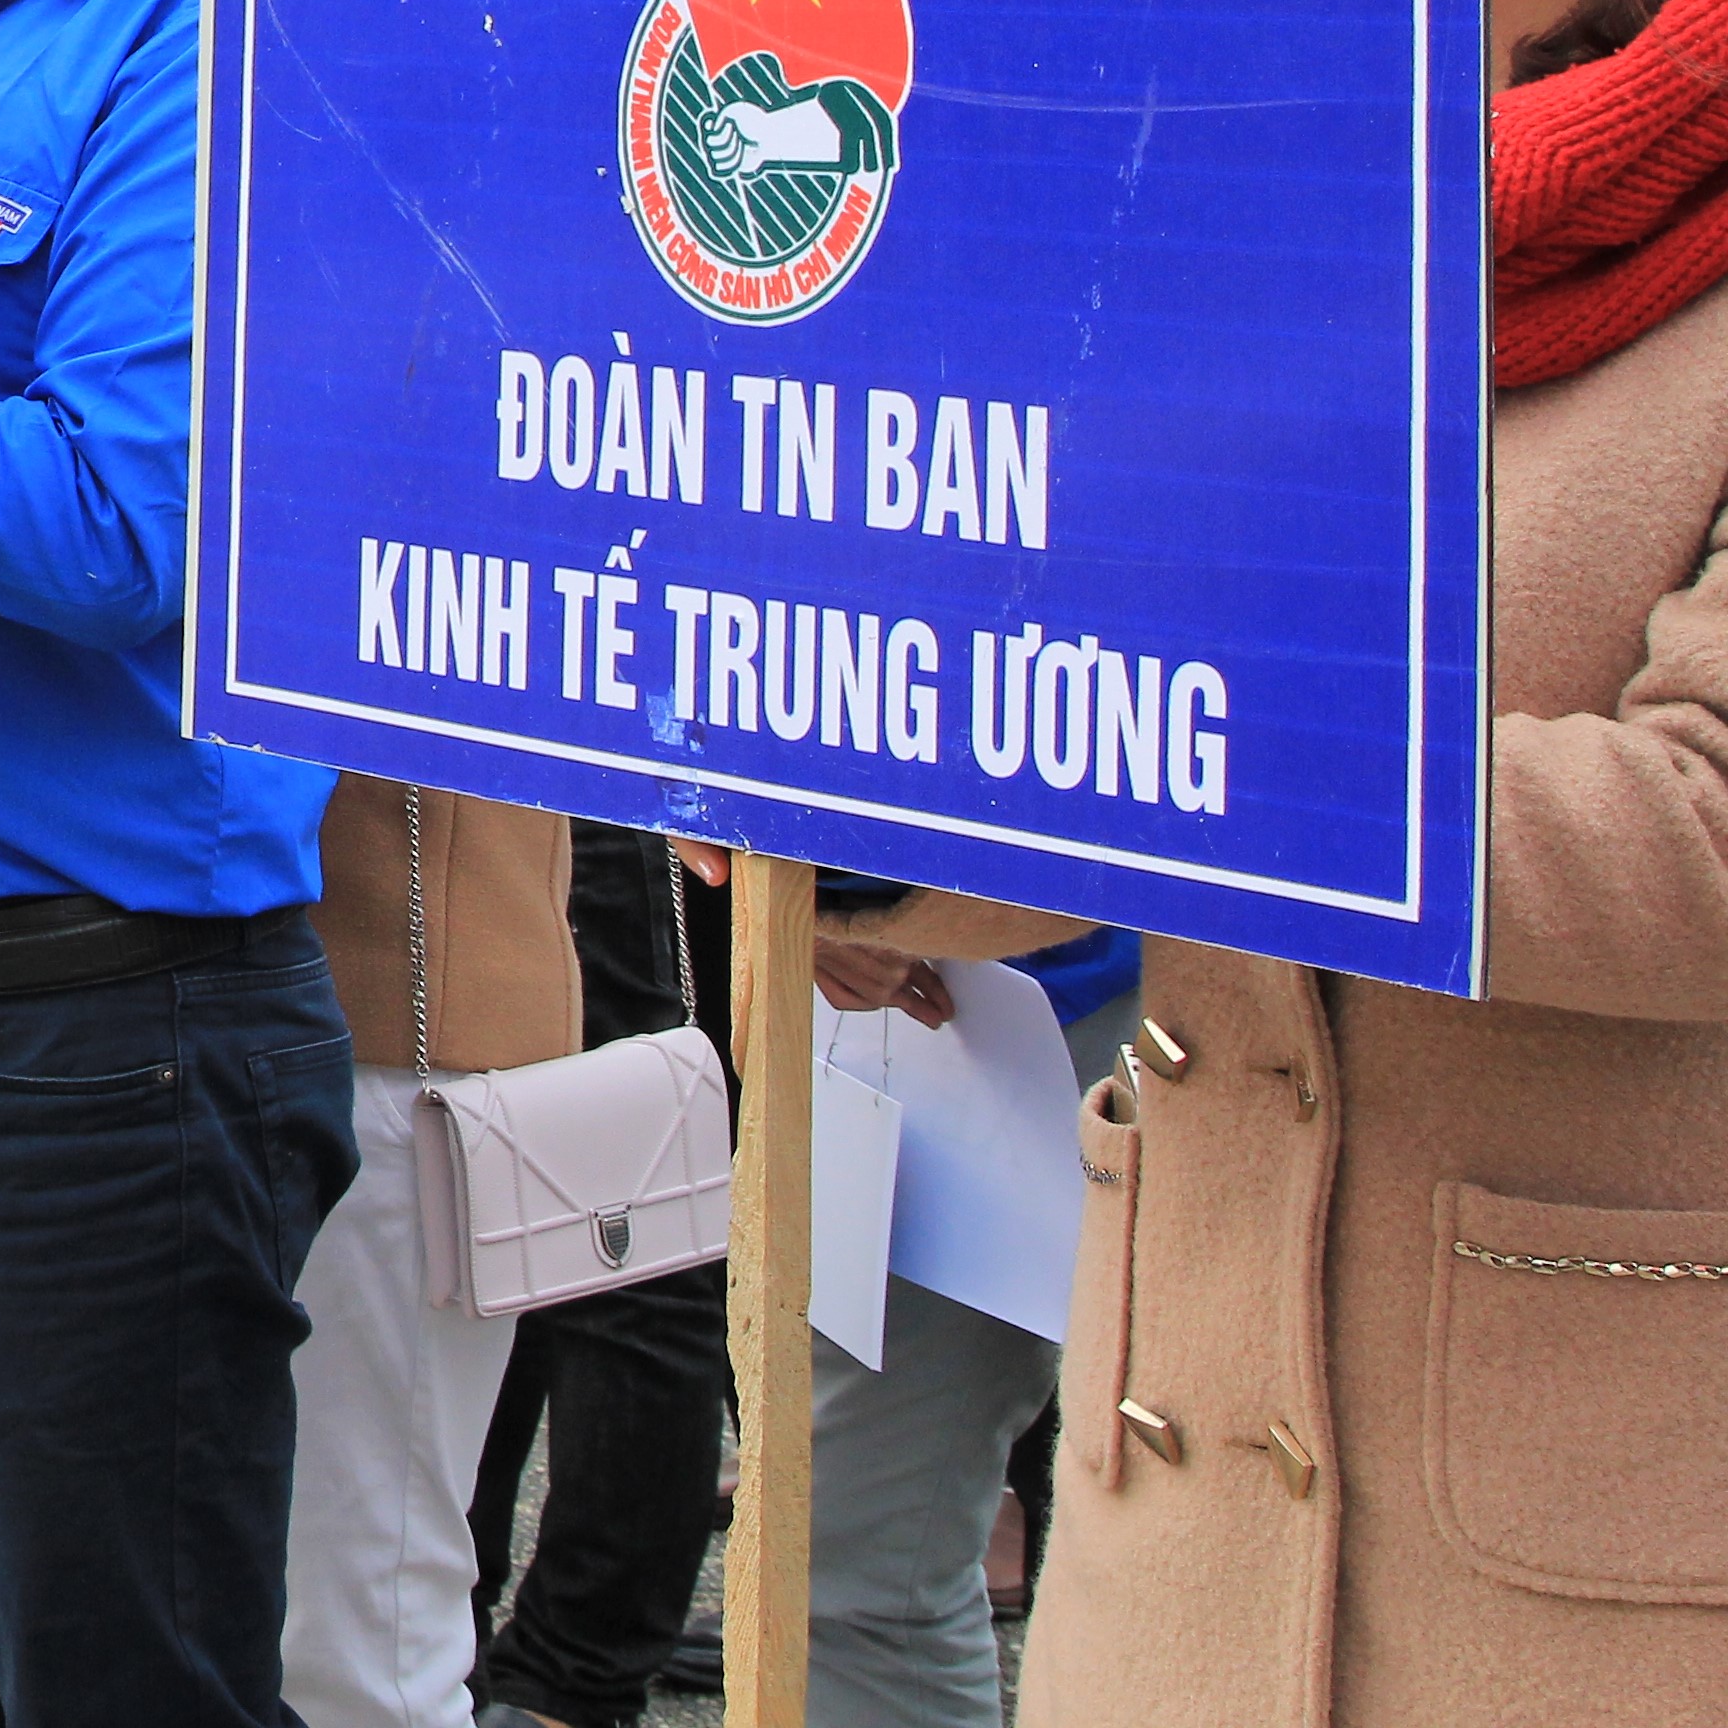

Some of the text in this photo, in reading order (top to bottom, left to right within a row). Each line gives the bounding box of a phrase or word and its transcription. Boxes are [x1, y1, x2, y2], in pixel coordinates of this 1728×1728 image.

[630, 75, 656, 171] THANH
[635, 169, 674, 245] NIÊN
[831, 184, 872, 263] MINH
[666, 234, 720, 297] CỘNG
[794, 242, 829, 295] CHÍ
[496, 331, 1049, 550] ĐOÀN TN BAN
[358, 528, 1228, 816] KINH TẾ TRUNG ƯƠNG
